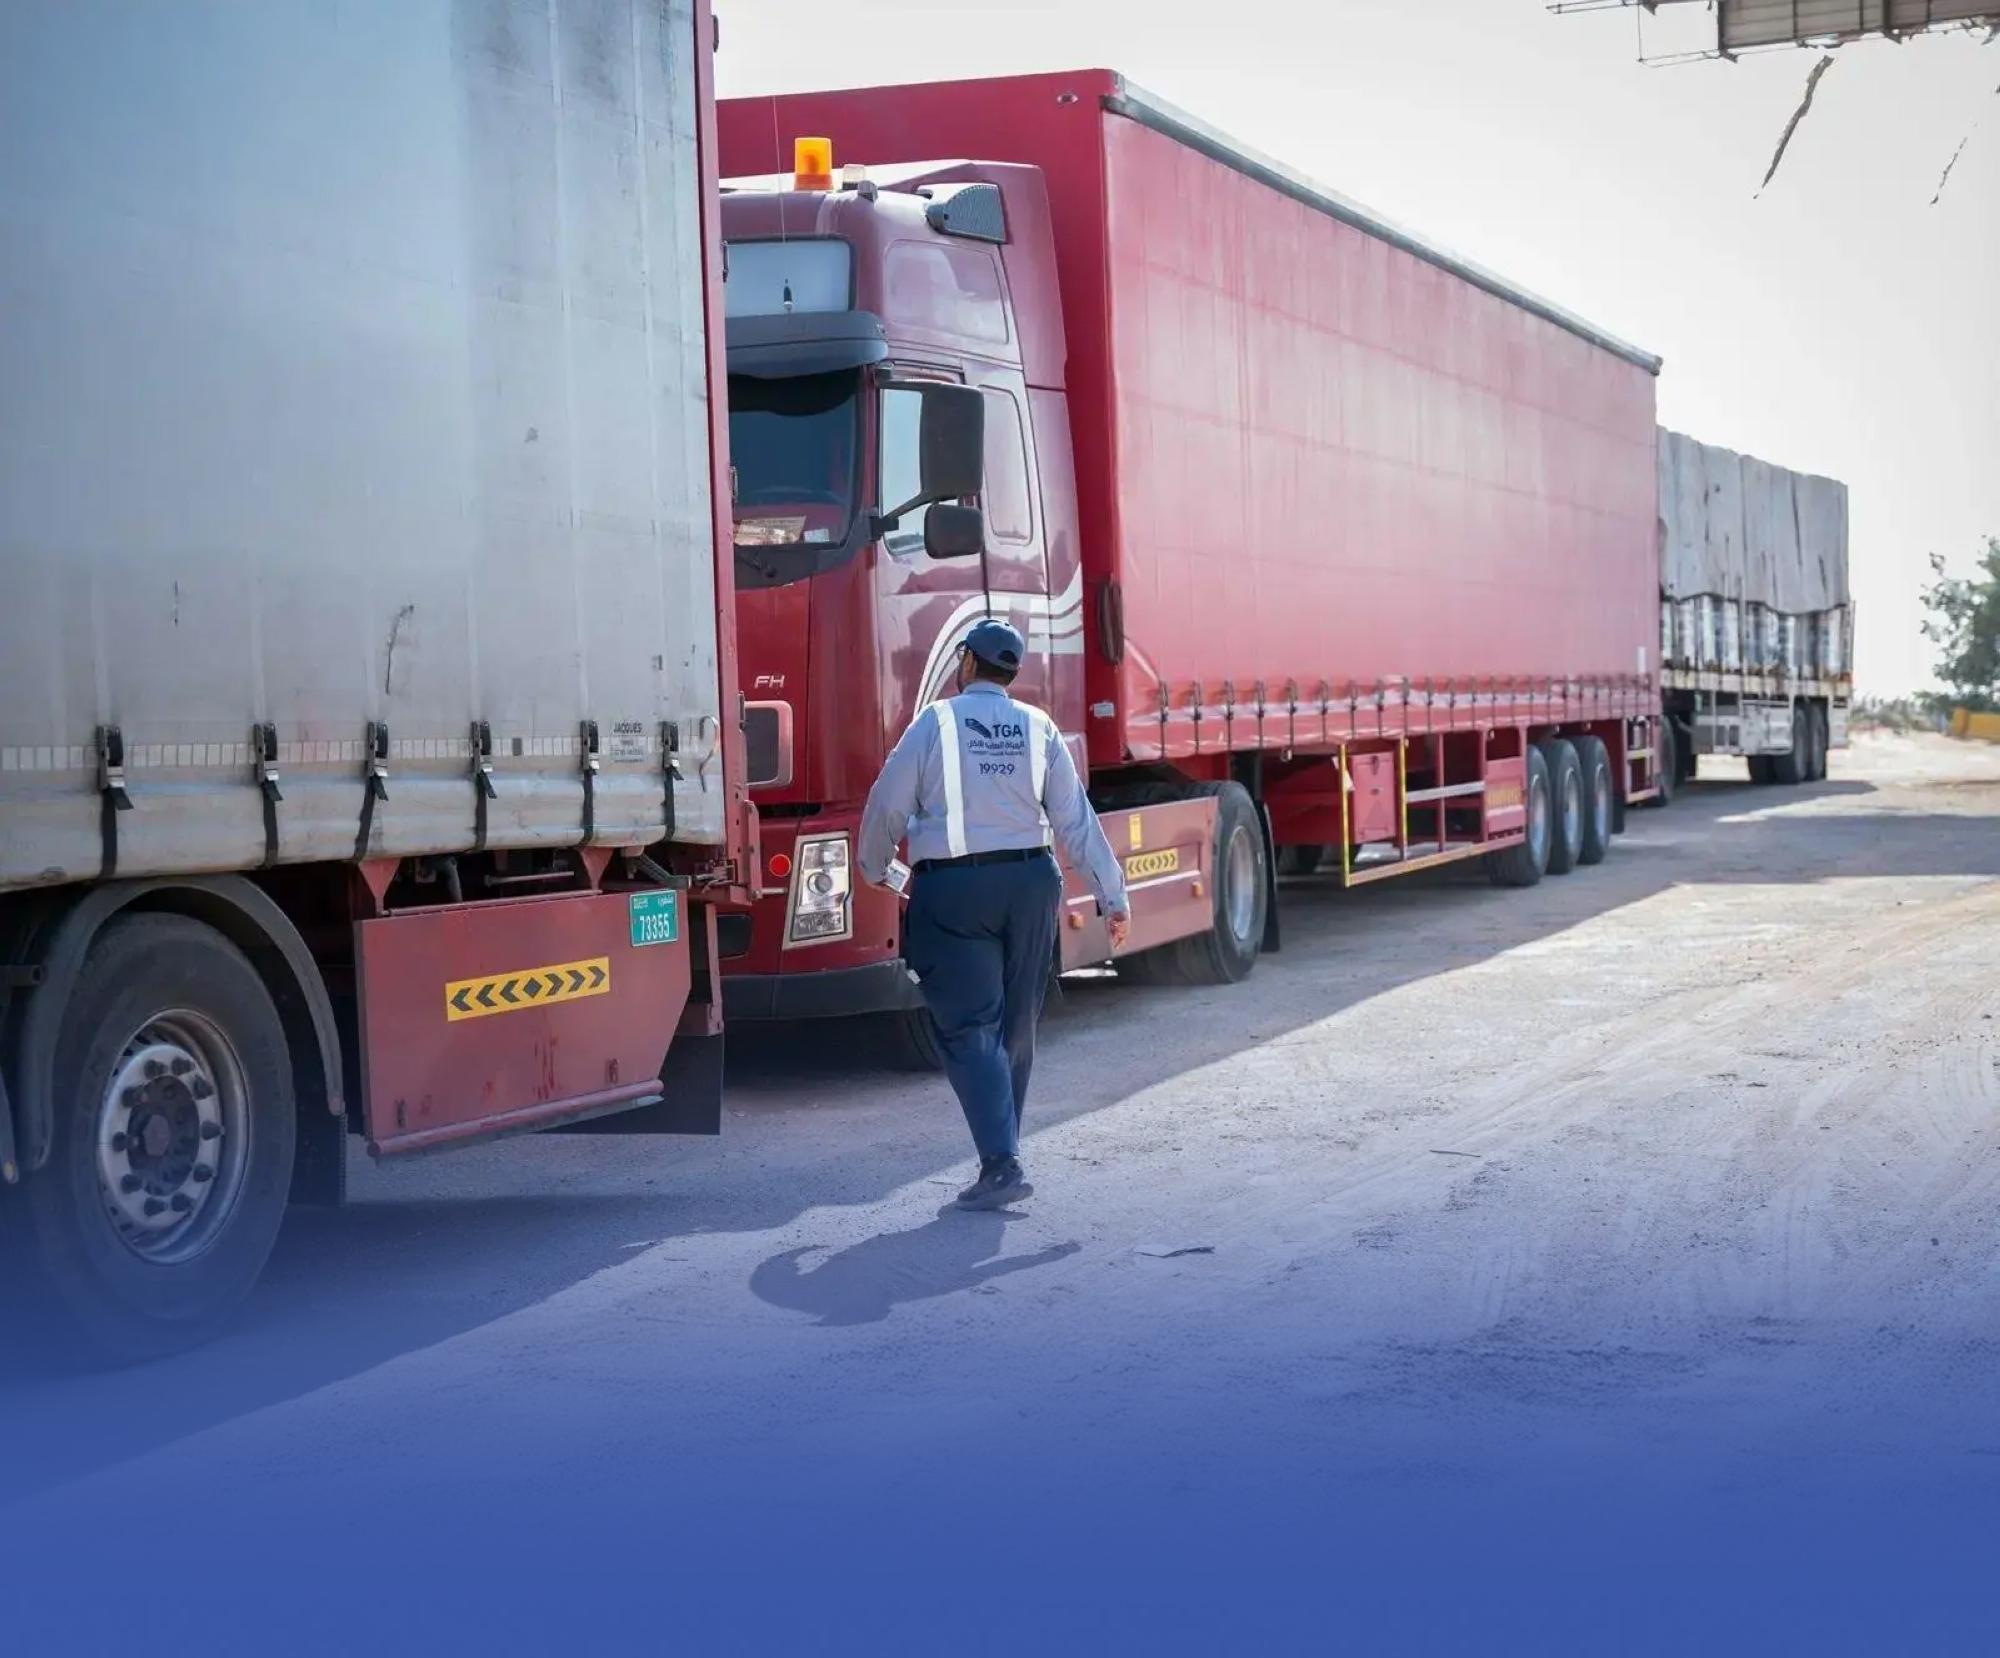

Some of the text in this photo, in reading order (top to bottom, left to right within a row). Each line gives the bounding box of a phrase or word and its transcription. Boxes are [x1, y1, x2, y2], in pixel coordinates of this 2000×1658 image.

[754, 674, 785, 689] FH
[613, 721, 643, 734] JACQUES
[992, 724, 1023, 738] TGA
[979, 763, 1015, 775] 19929
[639, 913, 670, 941] 73355
